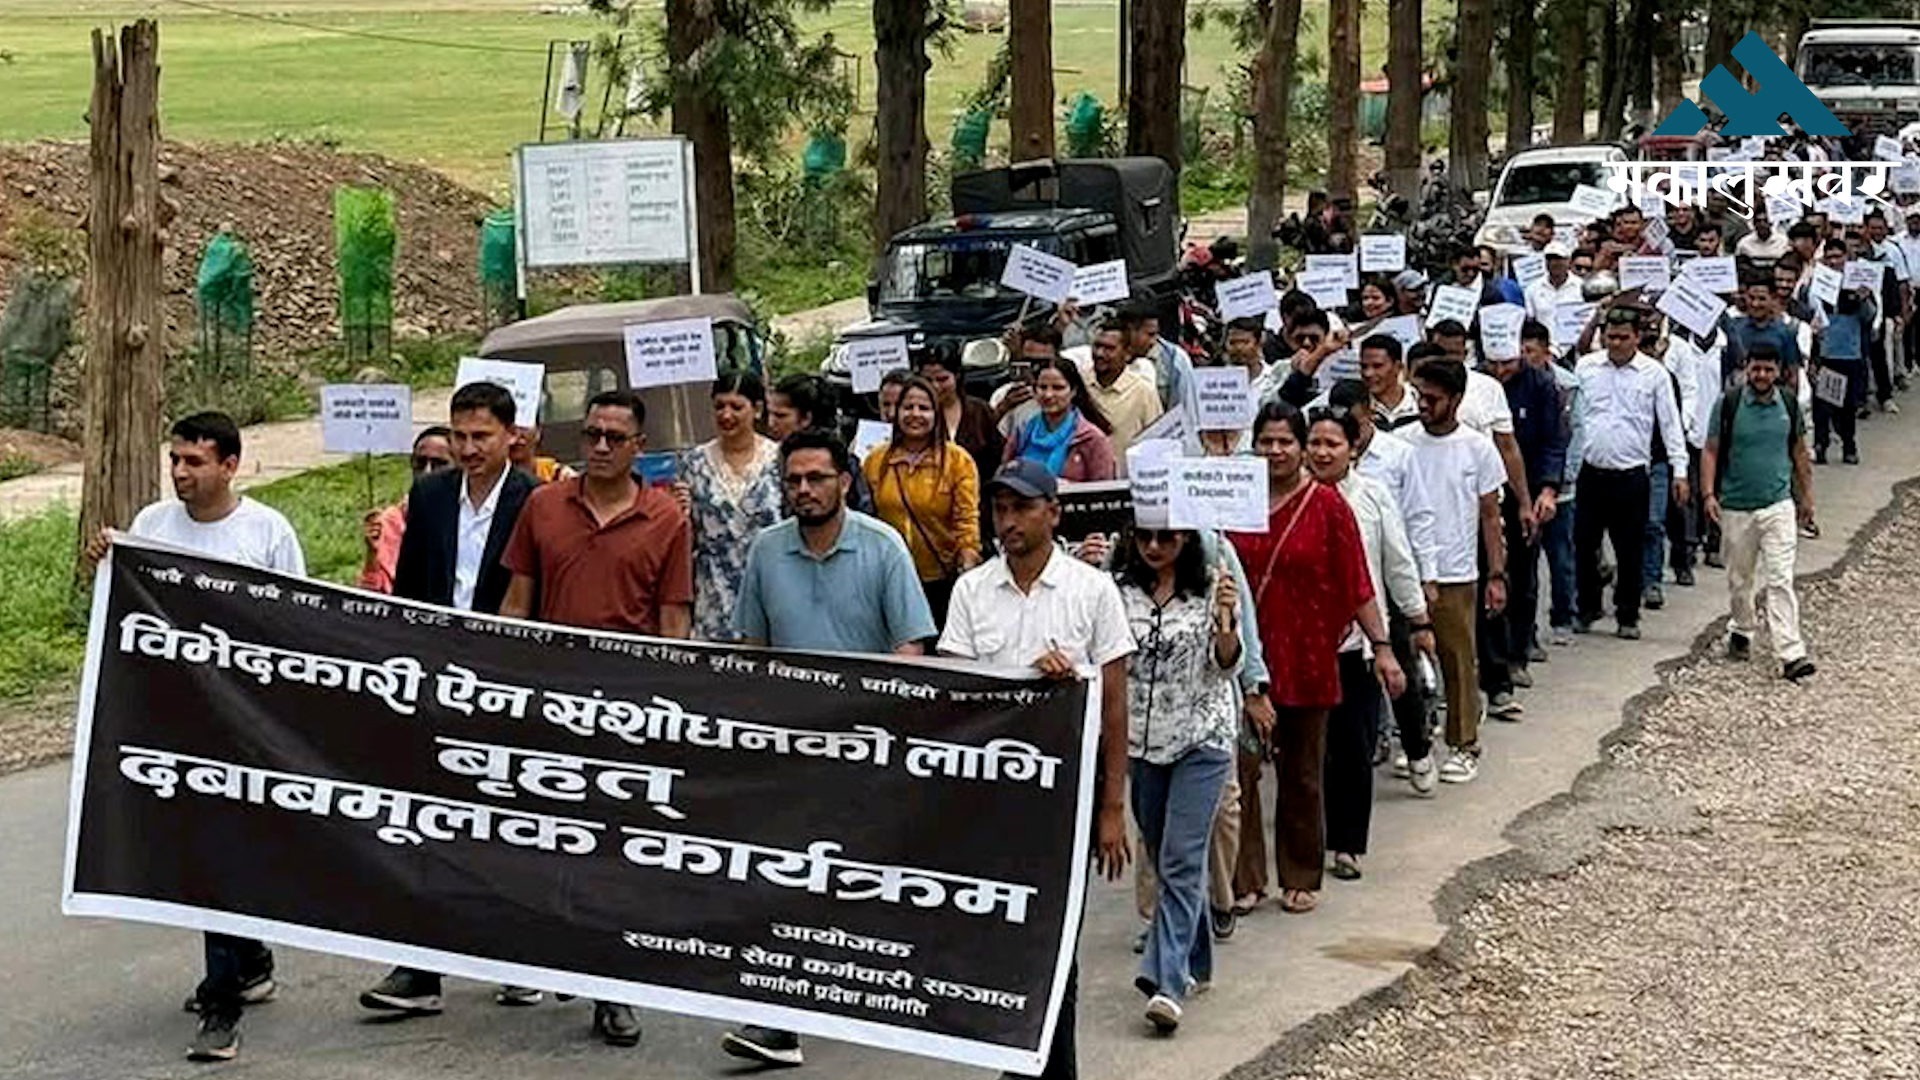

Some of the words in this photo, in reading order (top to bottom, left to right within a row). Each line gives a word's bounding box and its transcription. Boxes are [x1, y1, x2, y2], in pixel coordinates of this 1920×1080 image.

[194, 573, 238, 593] सेवा
[118, 612, 426, 714] विभेदकारी
[437, 664, 534, 719] ऐन
[543, 689, 896, 766] संशोधनको
[906, 737, 1063, 790] लागि
[434, 736, 686, 820] बृहत्
[118, 744, 606, 855] दबाबमूलक
[620, 825, 1038, 924] कार्यक्रम
[622, 929, 733, 959] स्थानीय
[740, 944, 796, 970] सेवा
[803, 959, 914, 990] कर्मचारी
[770, 922, 915, 958] आयोजक
[739, 972, 811, 997] कर्णाली
[814, 983, 861, 1004] प्रदेश
[865, 990, 931, 1018] समिति
